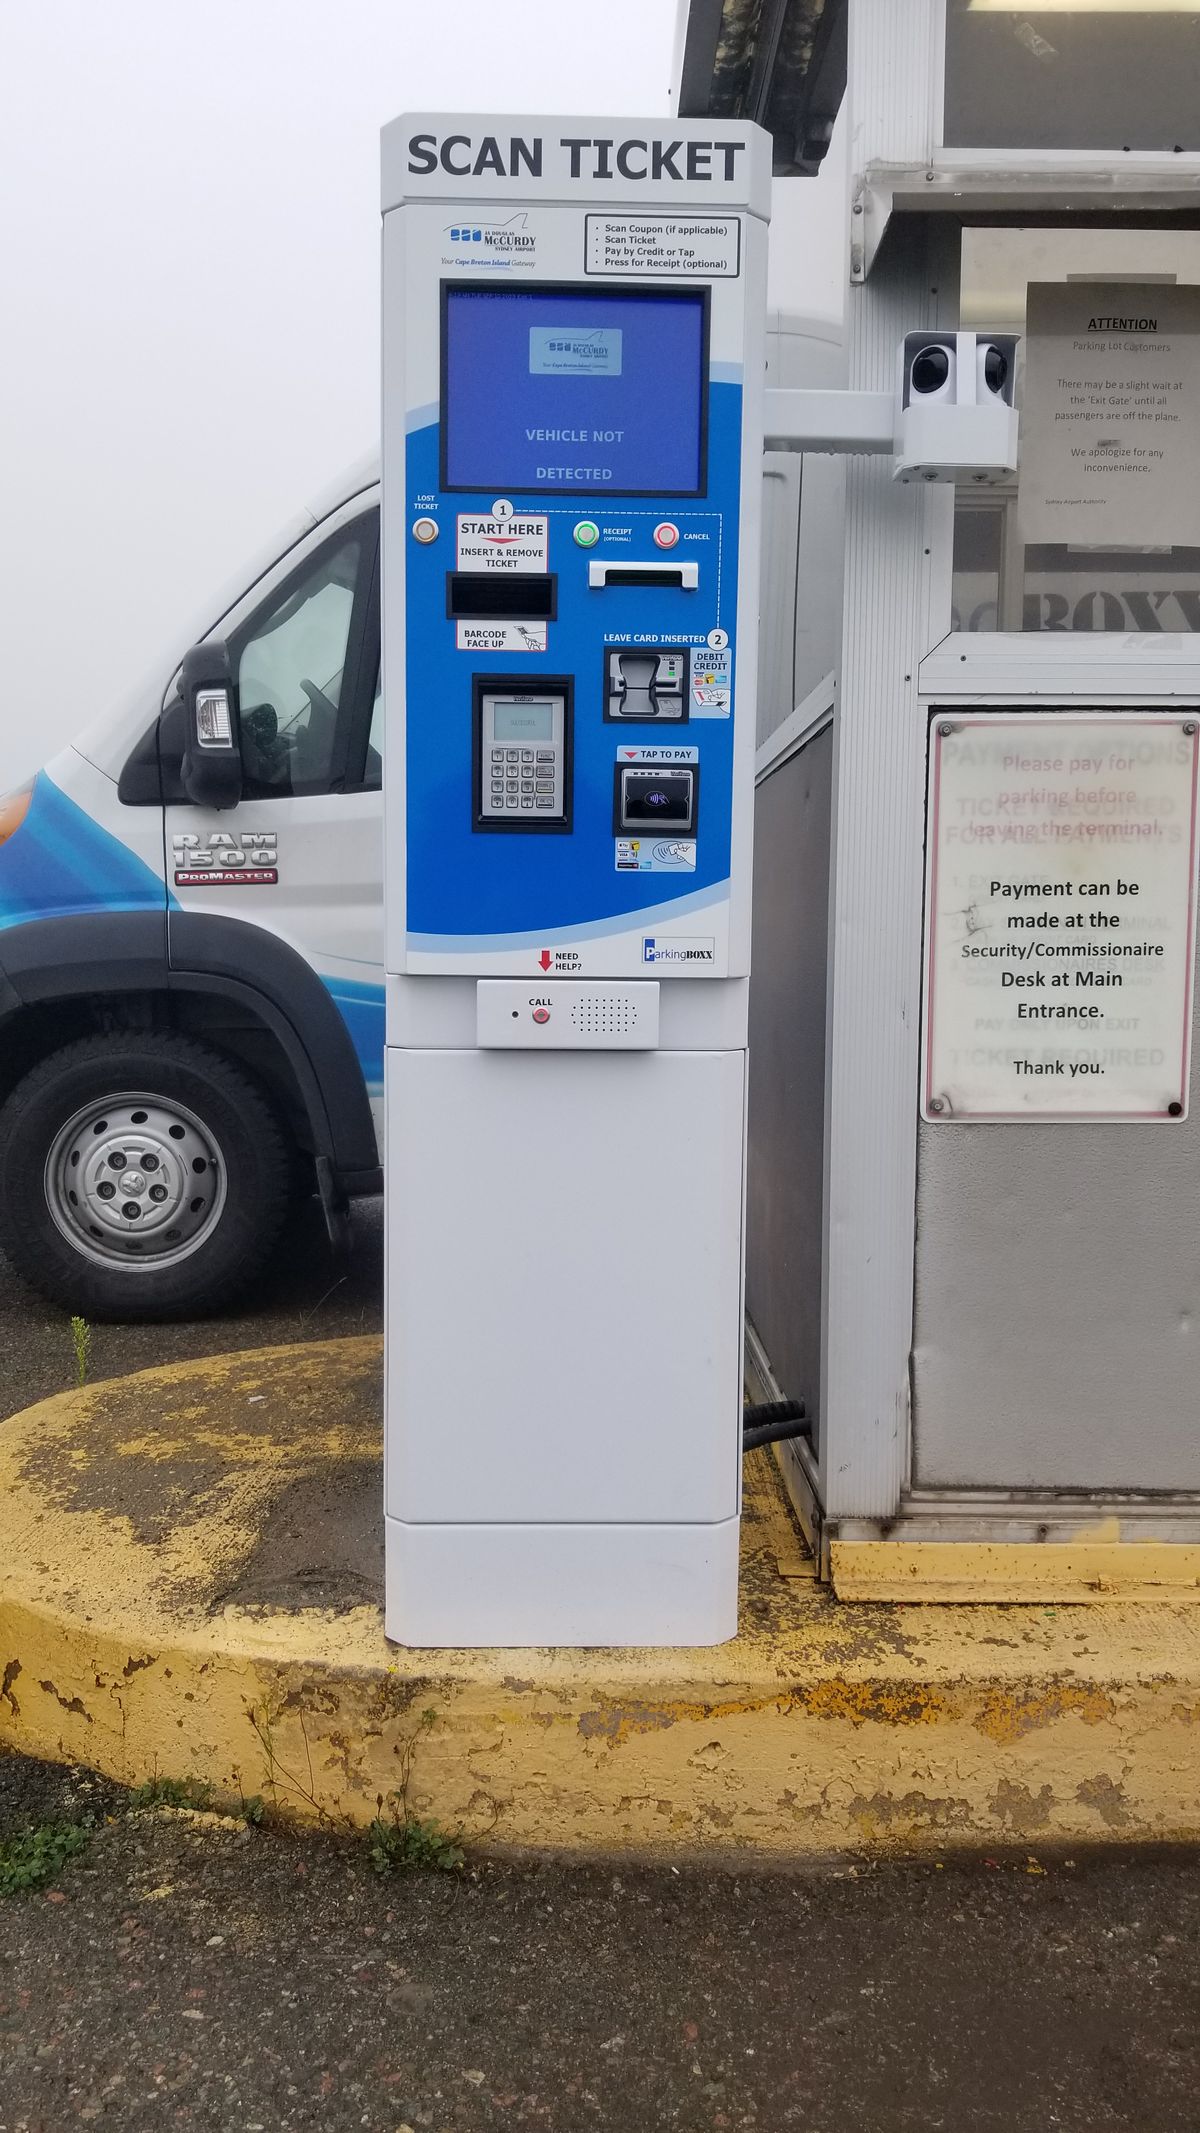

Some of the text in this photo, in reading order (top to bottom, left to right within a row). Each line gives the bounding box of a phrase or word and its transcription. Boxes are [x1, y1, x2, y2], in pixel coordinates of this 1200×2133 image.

[408, 134, 745, 182] SCAN TICKET
[605, 224, 728, 236] Scan Coupon (if applicable)
[484, 235, 537, 246] McCURDY
[605, 235, 656, 244] Scan Ticket
[605, 247, 620, 256] Pay
[624, 247, 634, 256] by
[637, 247, 664, 256] Credit
[679, 248, 695, 258] Tap
[441, 257, 454, 265] Your
[455, 258, 470, 266] Cape
[511, 260, 536, 268] Gateway
[605, 258, 728, 270] Press for Receipt (optional)
[1088, 318, 1157, 331] ATTENTION
[1073, 341, 1171, 352] Parking Lot Customers
[1057, 379, 1082, 389] There
[1084, 380, 1103, 390] may
[1105, 380, 1117, 389] be
[1125, 380, 1149, 391] slight
[1153, 381, 1170, 390] wait
[1173, 382, 1183, 390] at
[1070, 396, 1085, 405] the
[1134, 396, 1154, 405] until
[1157, 397, 1167, 405] all
[1055, 411, 1181, 422] passengers are off the plane.
[525, 429, 624, 443] VEHICLE NOT
[1071, 448, 1164, 459] We apologize for any
[536, 467, 612, 480] DETECTED
[499, 505, 507, 516] 1
[461, 523, 544, 536] START HERE
[460, 548, 544, 558] INSERT & REMOVE
[485, 559, 518, 567] TICKET
[464, 630, 507, 638] BARCODE
[604, 633, 706, 643] LEAVE CARD INSERTED
[714, 634, 722, 645] 2
[467, 640, 504, 648] FACE UP
[697, 653, 724, 661] DEBIT
[694, 662, 728, 670] CREDIT
[641, 750, 657, 758] TAP
[674, 751, 692, 759] PAY
[1002, 754, 1136, 775] Please pay for
[998, 787, 1137, 808] parking before
[969, 819, 1163, 838] leaving the terminal.
[173, 832, 278, 850] RAM
[173, 850, 278, 867] 1500
[990, 881, 1073, 900] Payment
[1078, 883, 1110, 896] can
[1116, 879, 1139, 896] be
[1007, 911, 1060, 928] made
[1065, 914, 1084, 928] at
[1089, 911, 1120, 928] the
[555, 952, 578, 960] NEED
[645, 943, 713, 961] ParkingBOXX
[961, 942, 1164, 960] Security/Commissionaire
[555, 962, 582, 971] HELP?
[1001, 971, 1046, 987] Desk
[1051, 972, 1070, 987] at
[1075, 971, 1123, 987] Main
[528, 998, 553, 1006] CALL
[1017, 1003, 1105, 1019] Entrance.
[1013, 1060, 1105, 1078] Thank you.
